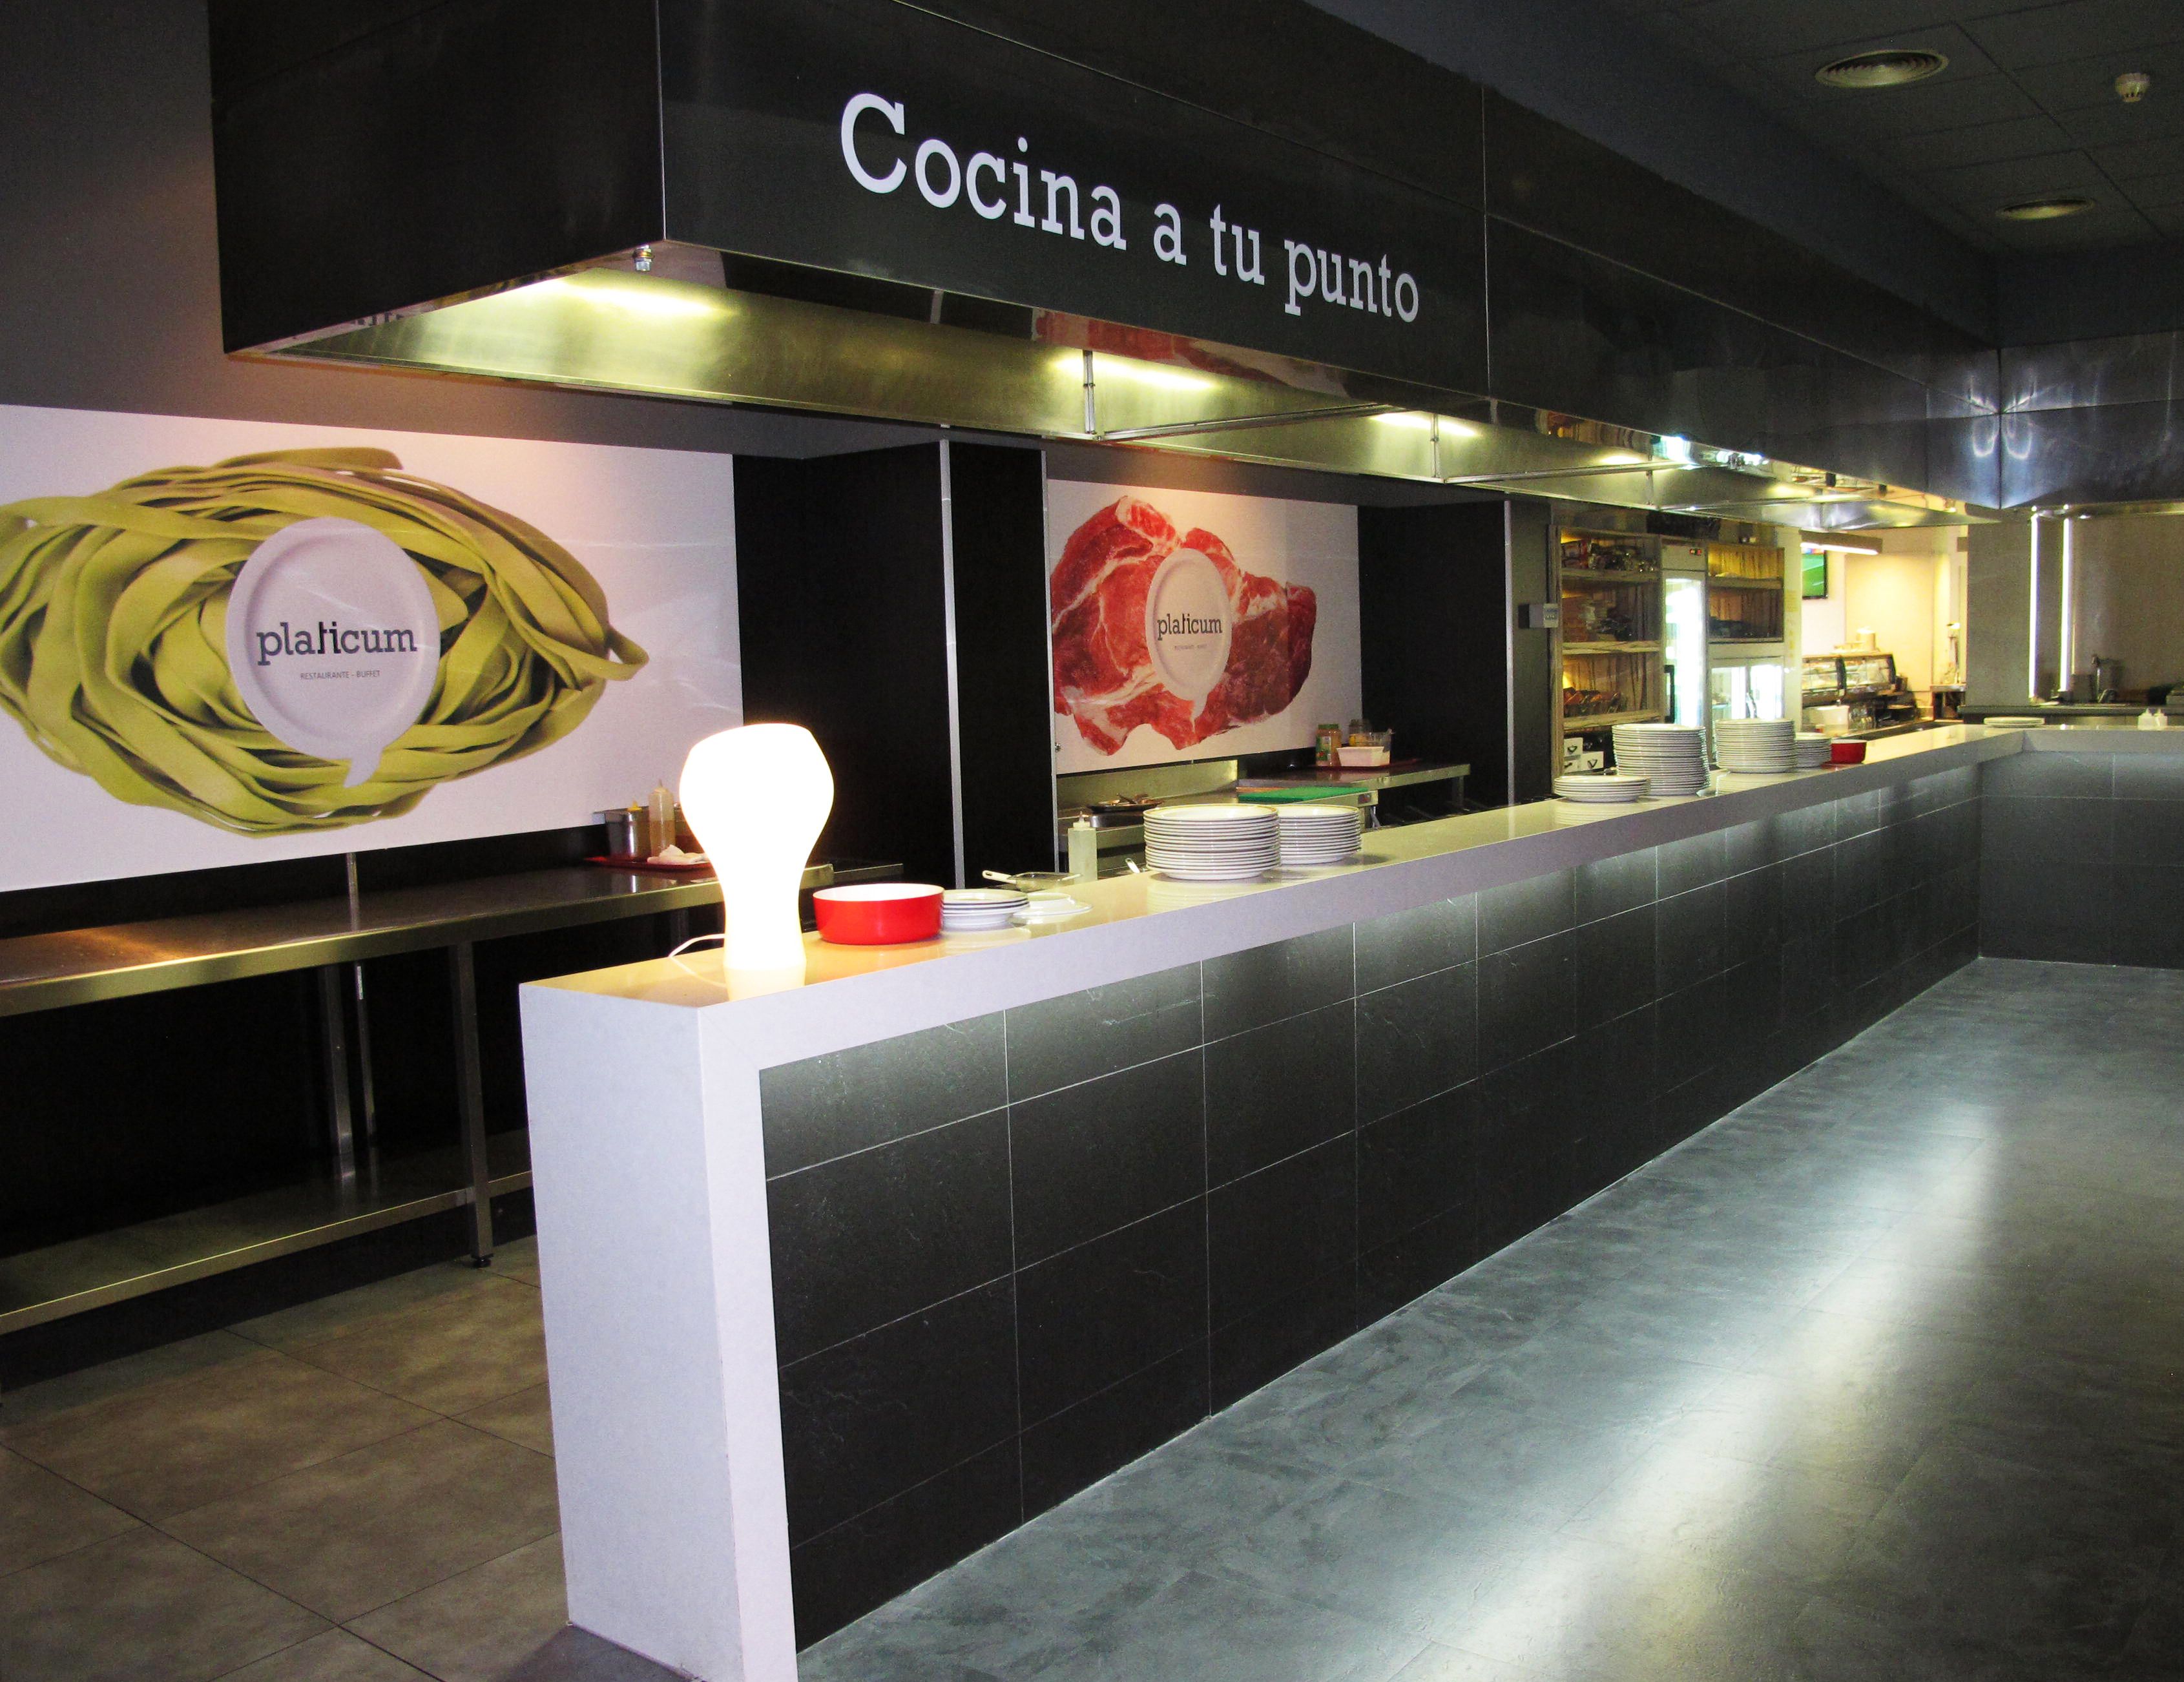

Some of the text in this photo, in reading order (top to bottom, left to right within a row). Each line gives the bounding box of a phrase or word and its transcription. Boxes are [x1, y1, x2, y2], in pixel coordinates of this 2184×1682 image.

[840, 92, 1420, 323] Cocina a tu punto
[256, 621, 418, 666] platicum
[1157, 613, 1223, 641] platicum
[300, 671, 349, 680] RESTAURANTE
